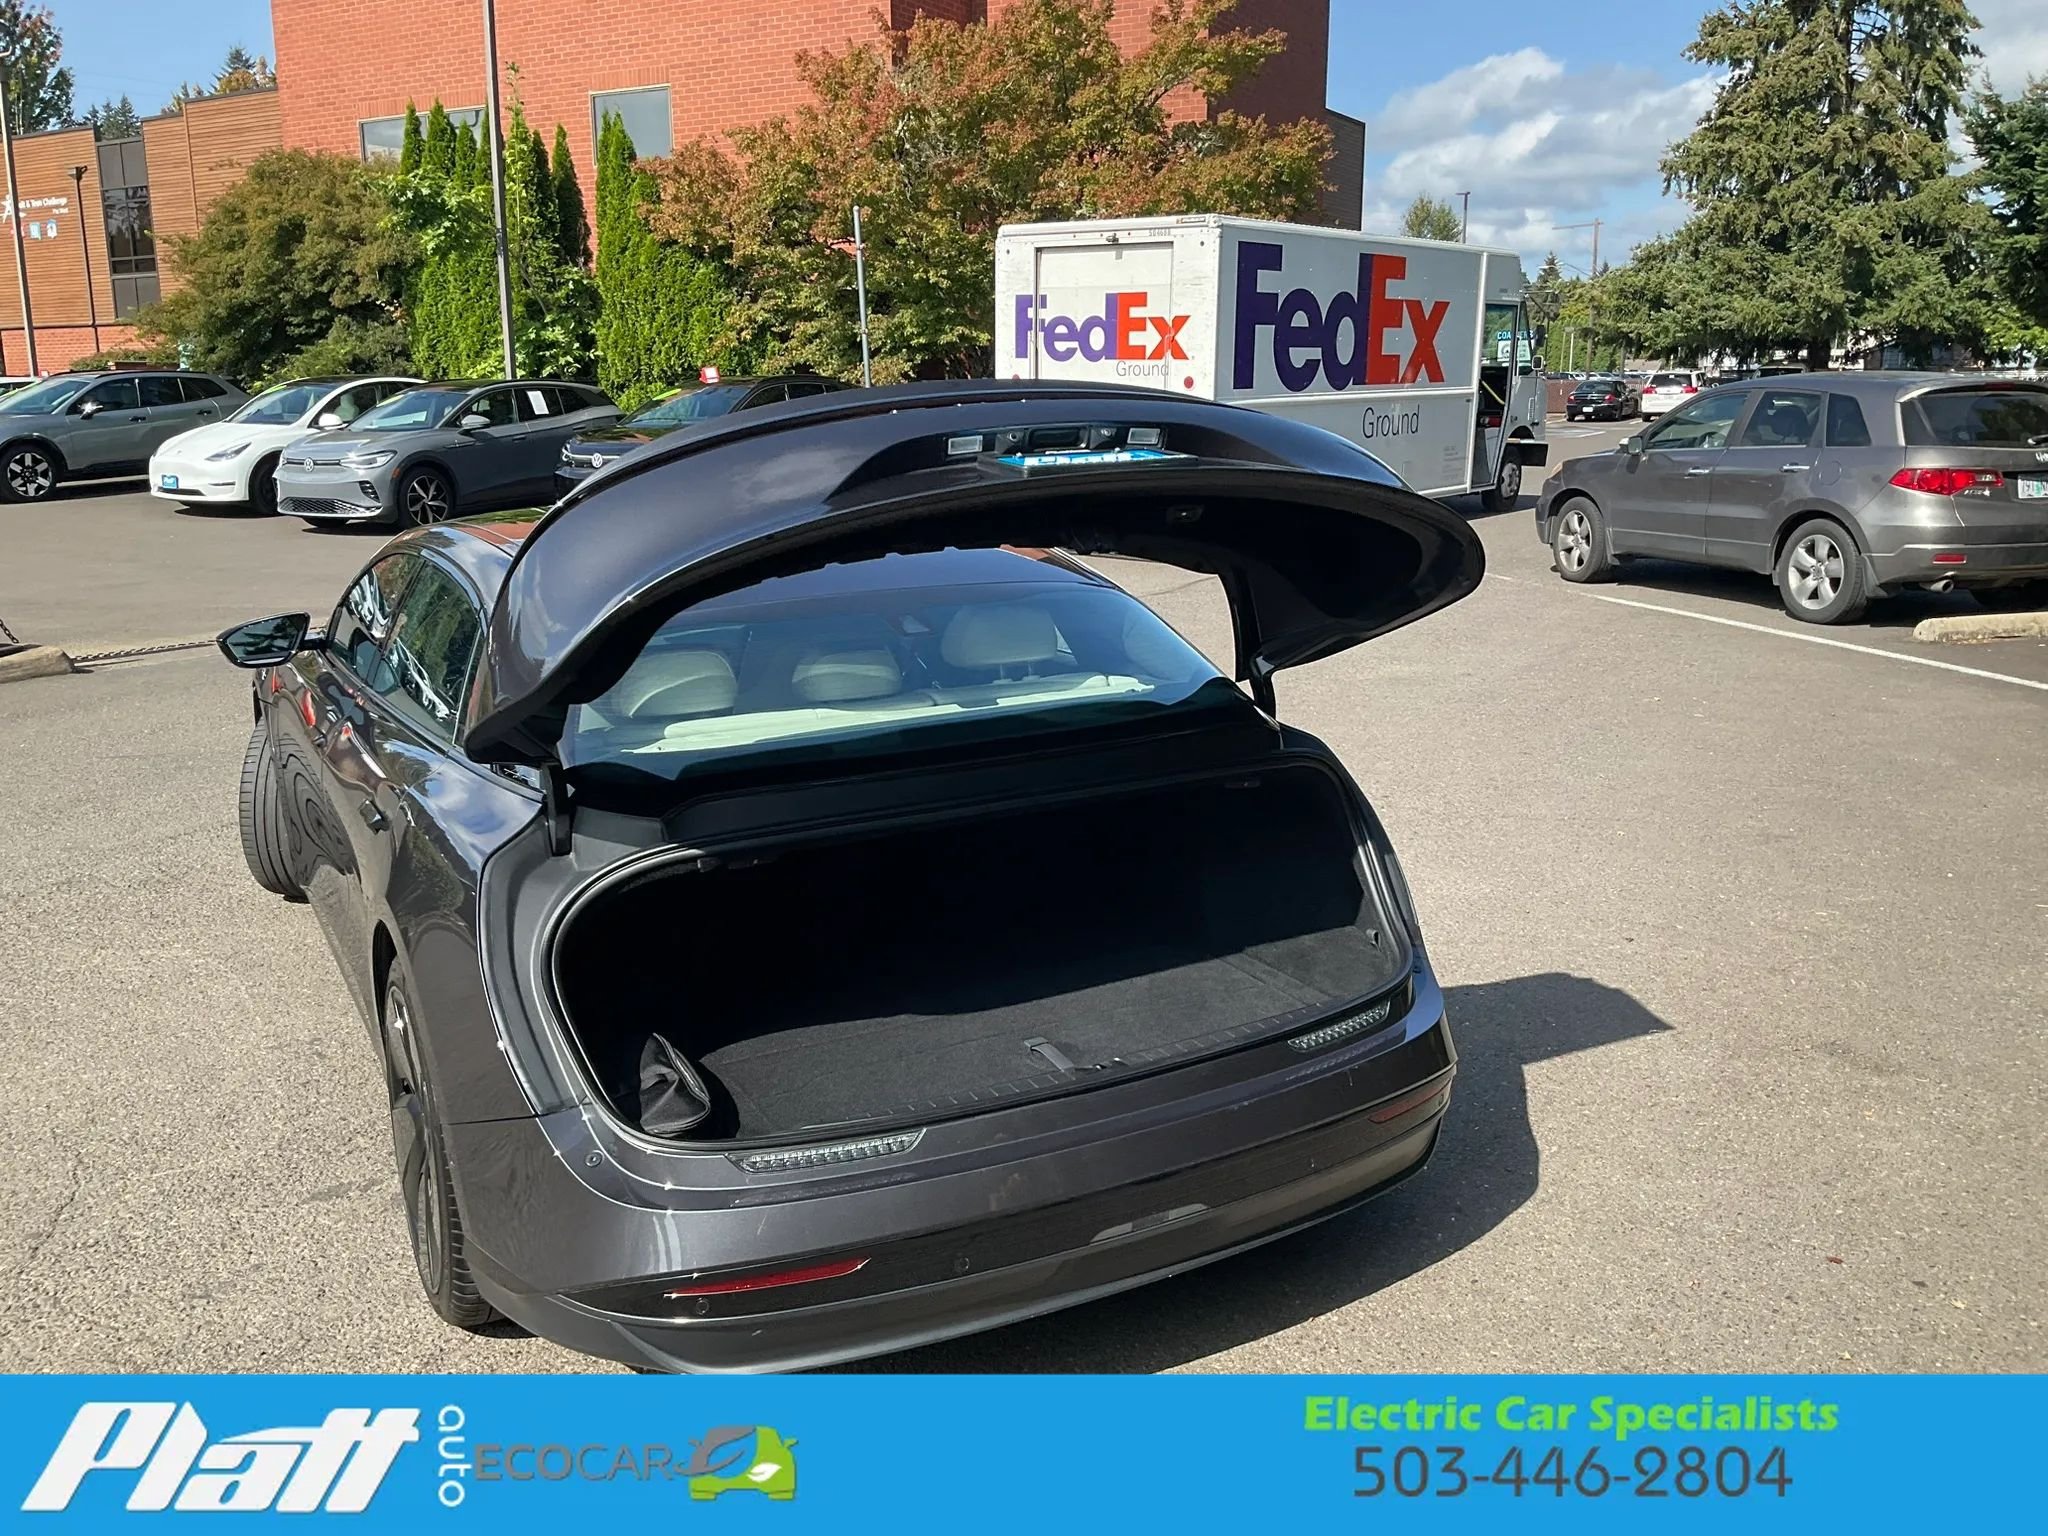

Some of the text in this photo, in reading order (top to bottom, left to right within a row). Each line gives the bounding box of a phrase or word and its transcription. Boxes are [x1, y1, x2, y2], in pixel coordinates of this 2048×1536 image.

[1015, 291, 1191, 363] FedEx
[1233, 240, 1450, 393] FedEx
[1115, 360, 1170, 377] Ground
[1362, 404, 1420, 439] Ground
